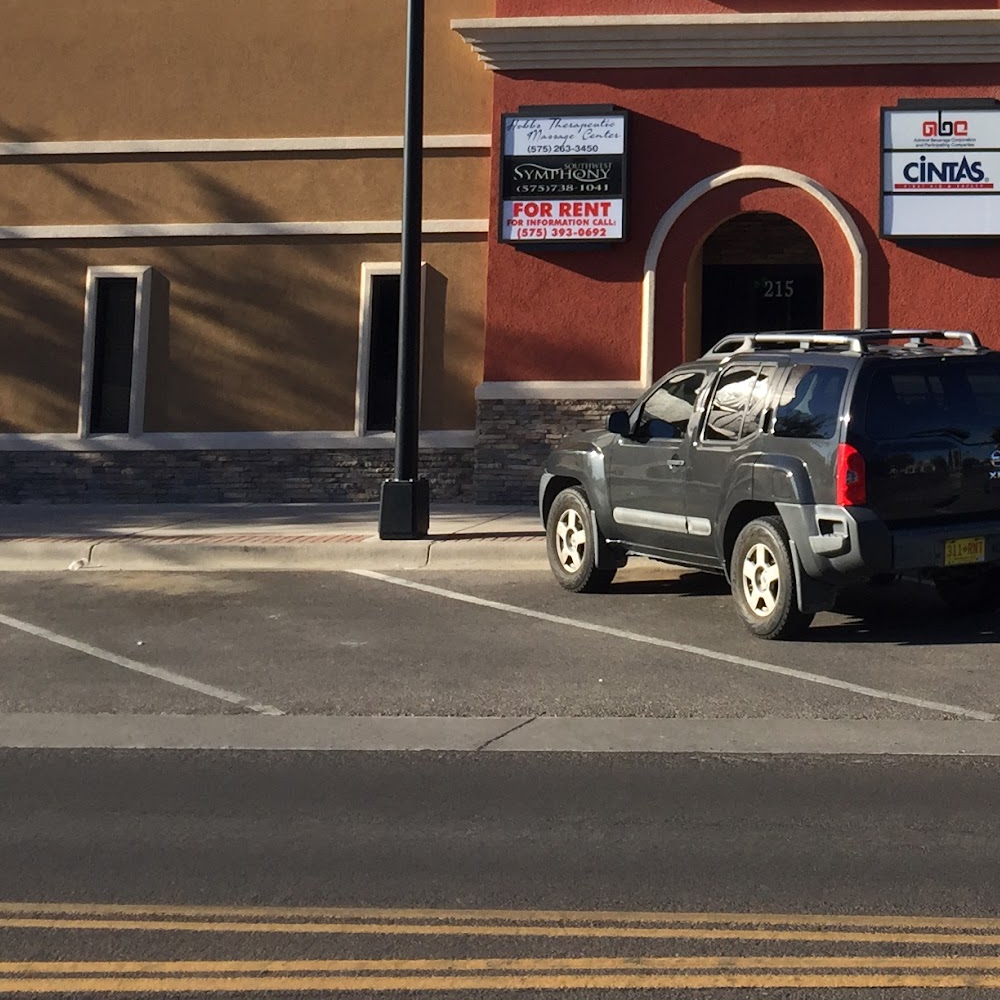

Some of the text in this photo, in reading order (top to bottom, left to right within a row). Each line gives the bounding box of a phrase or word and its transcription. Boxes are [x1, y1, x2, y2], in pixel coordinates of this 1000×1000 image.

[549, 117, 616, 133] Therapeutic
[527, 128, 621, 145] Massage Center
[527, 144, 599, 154] (575) 263-3450
[514, 163, 611, 183] SYMPHONY
[563, 162, 613, 170] SOUTHWEST
[513, 202, 612, 218] FOR RENT
[507, 218, 617, 227] FOR INFORMATION CALL:
[517, 227, 607, 239] (575) 393-0692
[764, 280, 794, 298] 215
